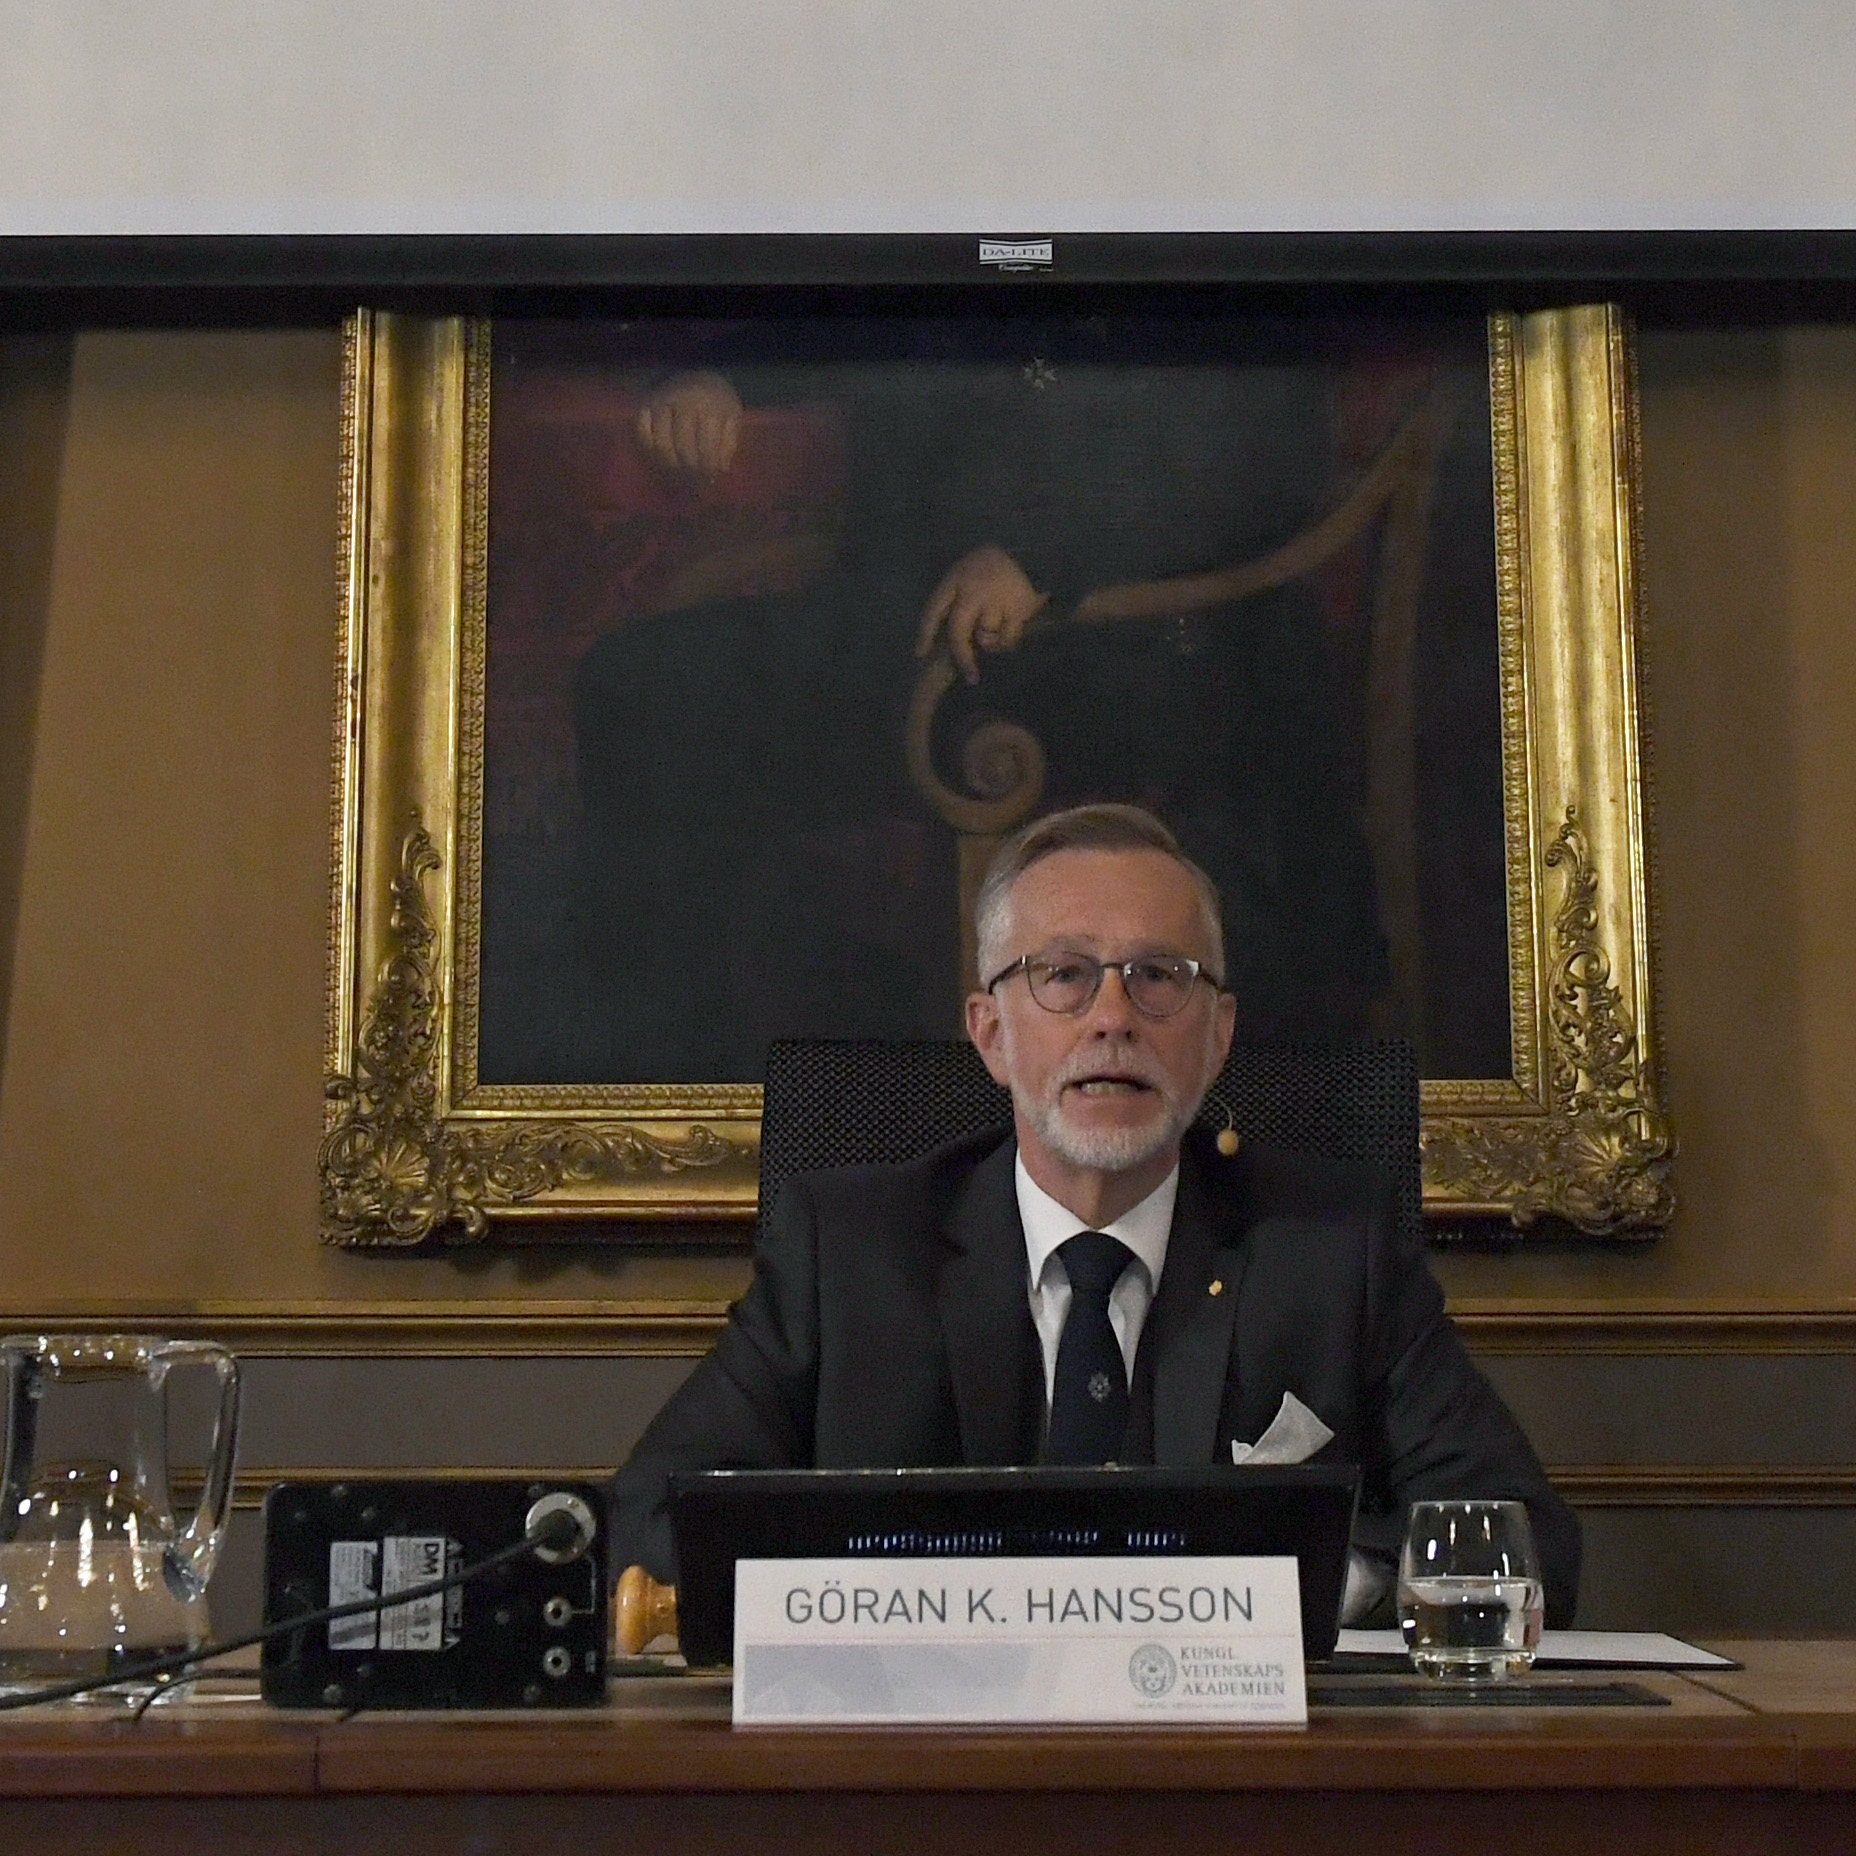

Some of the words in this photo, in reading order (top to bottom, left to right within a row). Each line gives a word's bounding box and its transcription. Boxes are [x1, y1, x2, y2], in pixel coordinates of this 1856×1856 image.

[785, 1580, 948, 1625] GÖRAN
[967, 1588, 1008, 1624] K.
[1026, 1586, 1254, 1624] HANSSON
[1182, 1681, 1285, 1695] AKADEMIEN
